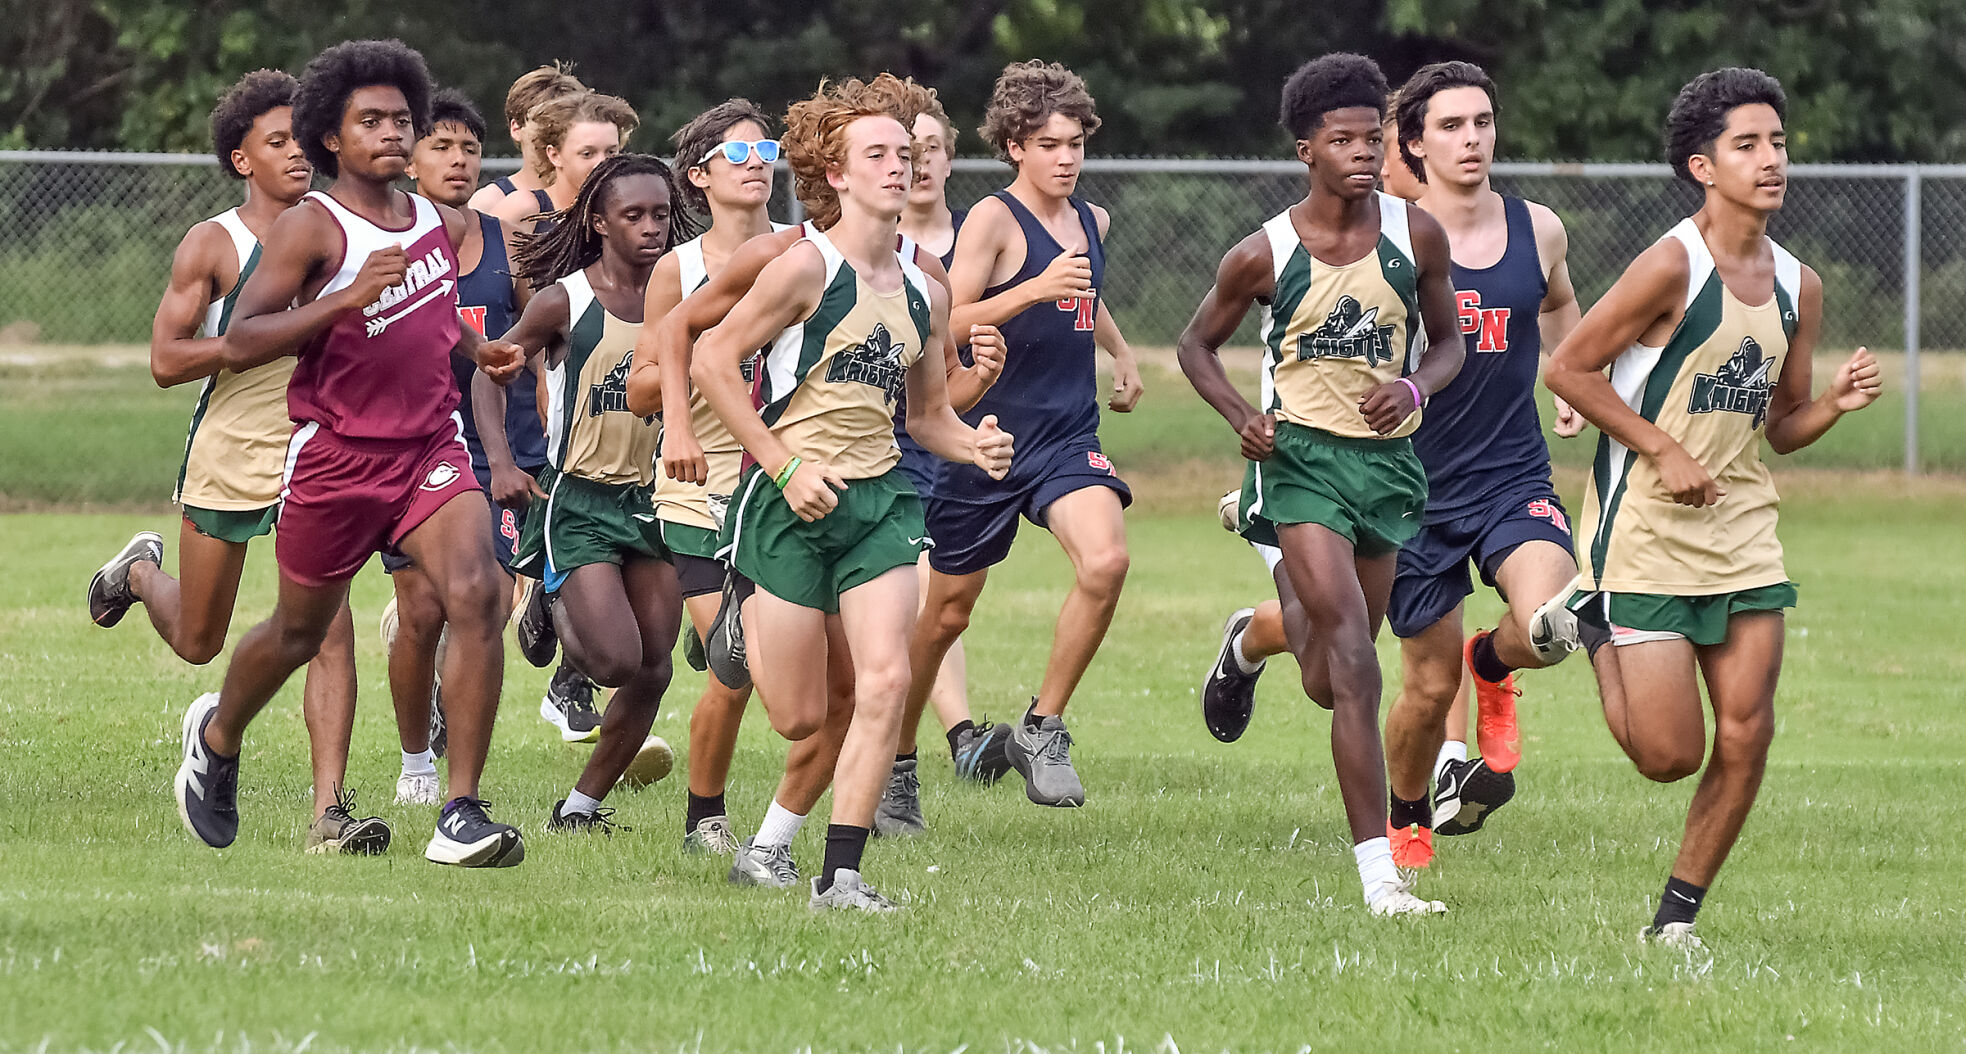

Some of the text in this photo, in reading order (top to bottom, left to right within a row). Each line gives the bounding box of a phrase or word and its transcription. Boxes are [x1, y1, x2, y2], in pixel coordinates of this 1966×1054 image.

[455, 293, 488, 342] N
[1456, 290, 1510, 352] SN
[1297, 324, 1396, 368] KNIGHTS
